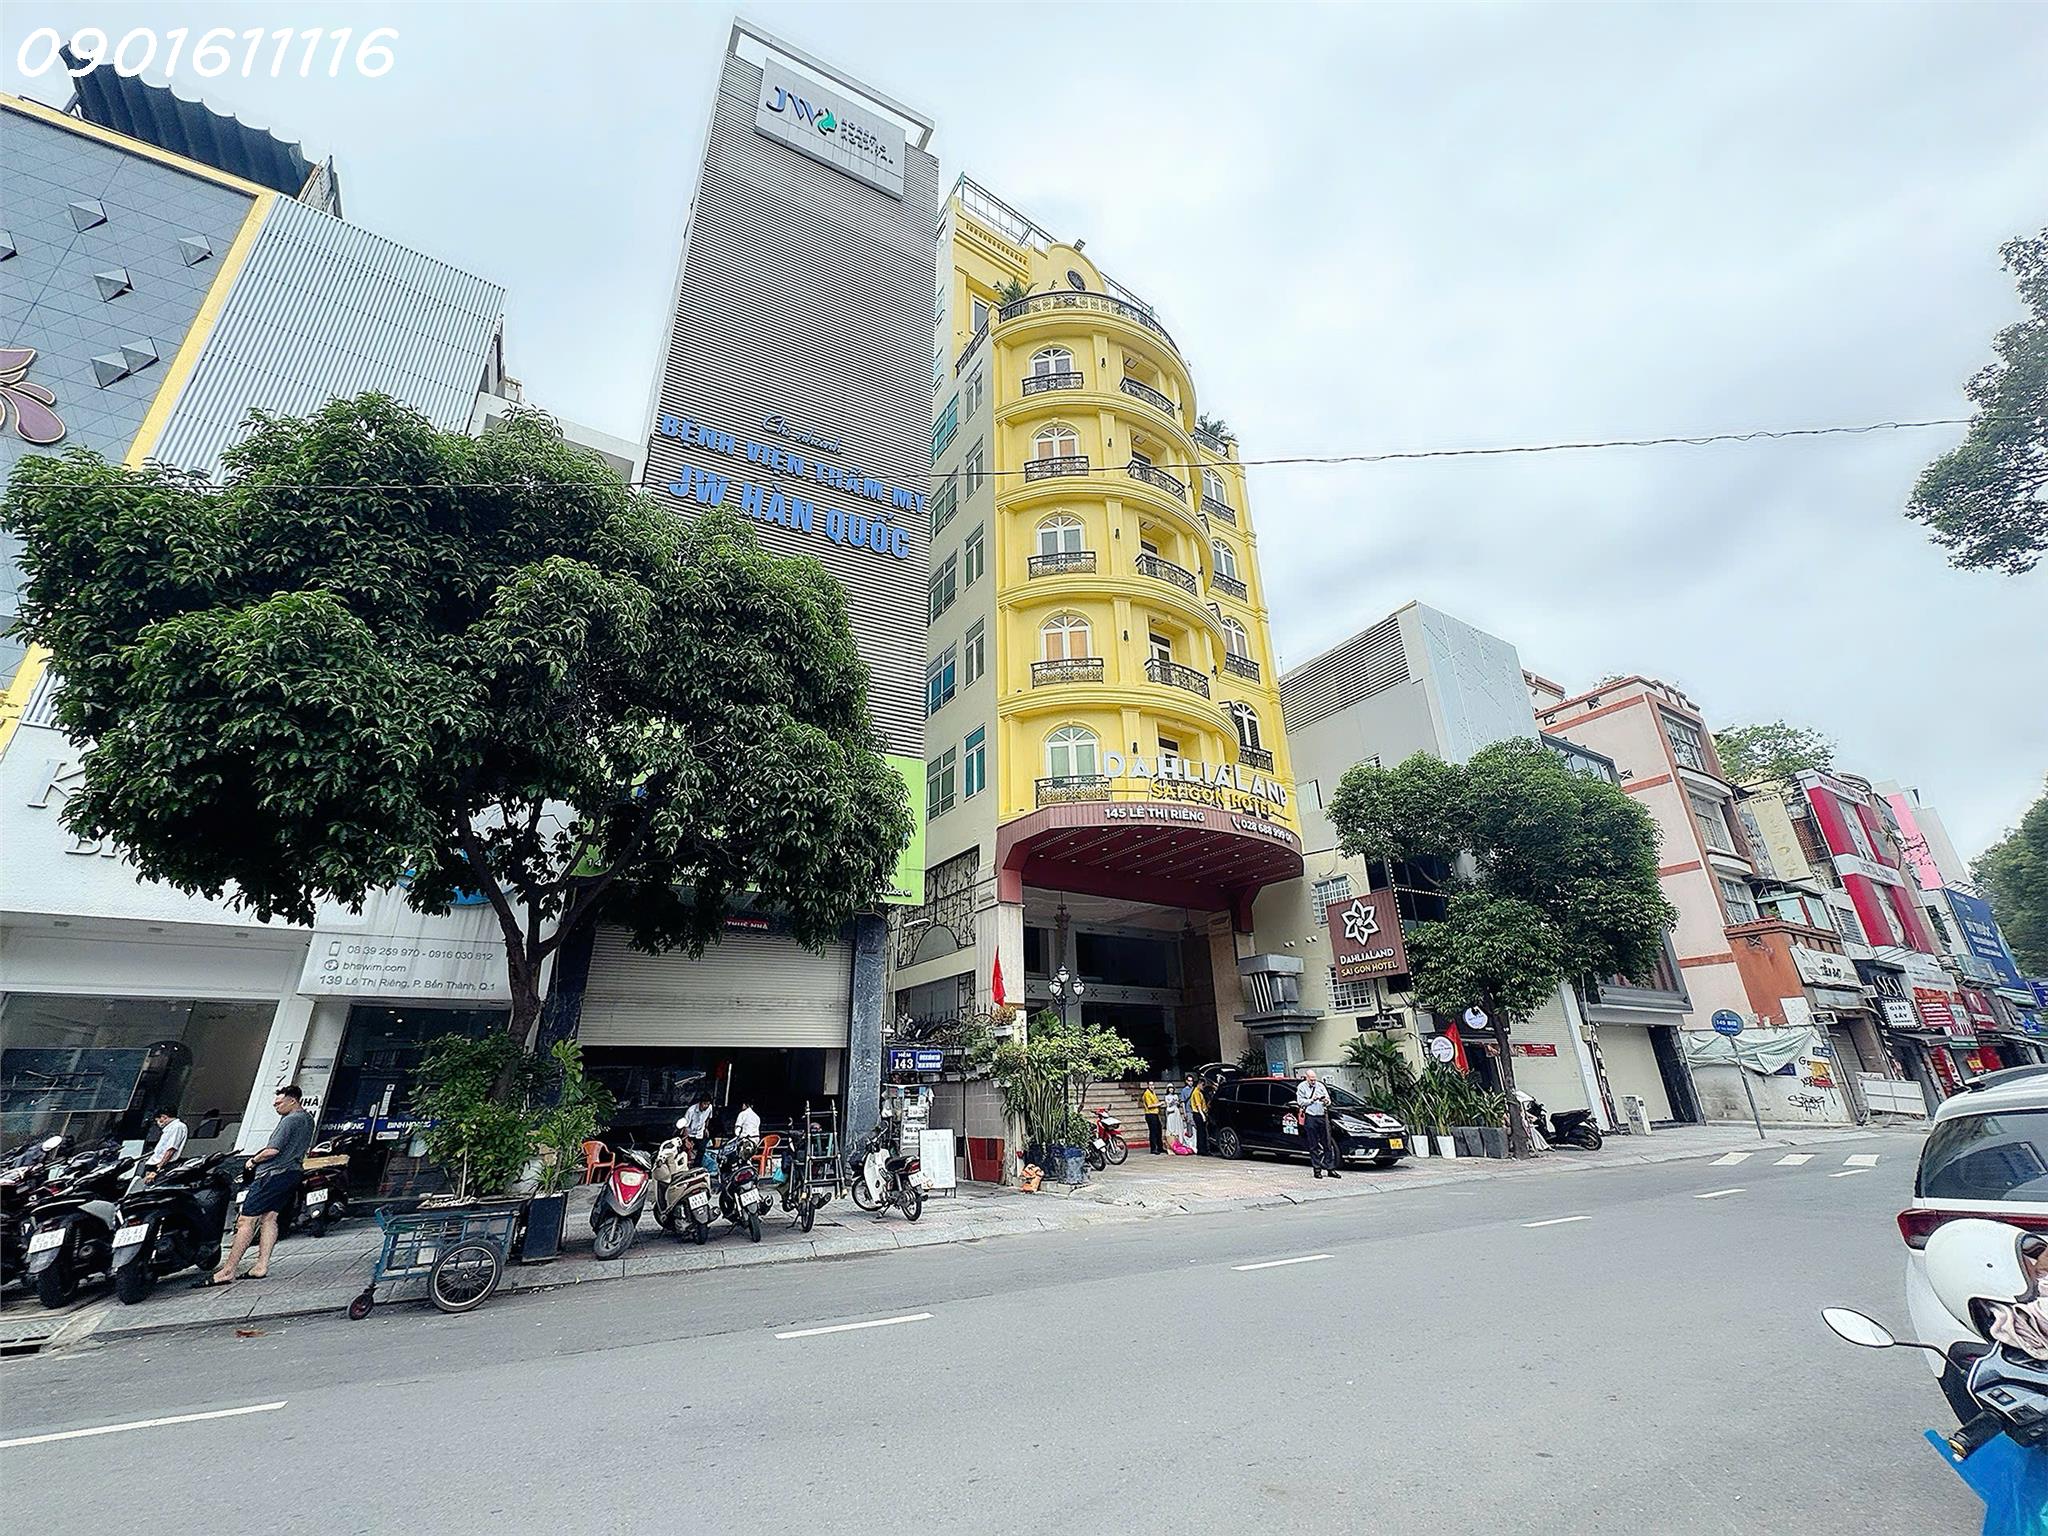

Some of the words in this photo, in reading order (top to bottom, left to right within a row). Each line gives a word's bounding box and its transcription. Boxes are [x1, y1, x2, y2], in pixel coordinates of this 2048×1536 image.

[766, 86, 824, 127] JW
[660, 414, 737, 457] BỆNH
[746, 441, 804, 477] VIỆN
[668, 464, 730, 507] JW
[740, 482, 814, 534] HÀN
[825, 507, 910, 560] QUỐC
[1104, 751, 1288, 807] DAHLIALAND
[1104, 807, 1127, 819] 145
[1129, 805, 1145, 818] LÊ
[1147, 808, 1169, 822] THỊ
[1171, 808, 1206, 822] RIÊNG
[400, 948, 420, 958] 970
[428, 949, 453, 959] 0916
[454, 951, 473, 960] 030
[474, 952, 494, 961] 812
[1340, 948, 1394, 965] DAHLIALAND
[1372, 960, 1398, 973] HOTEL
[319, 975, 343, 986] 139
[412, 979, 422, 988] P.
[275, 1042, 293, 1088] 137
[894, 1058, 914, 1070] 143
